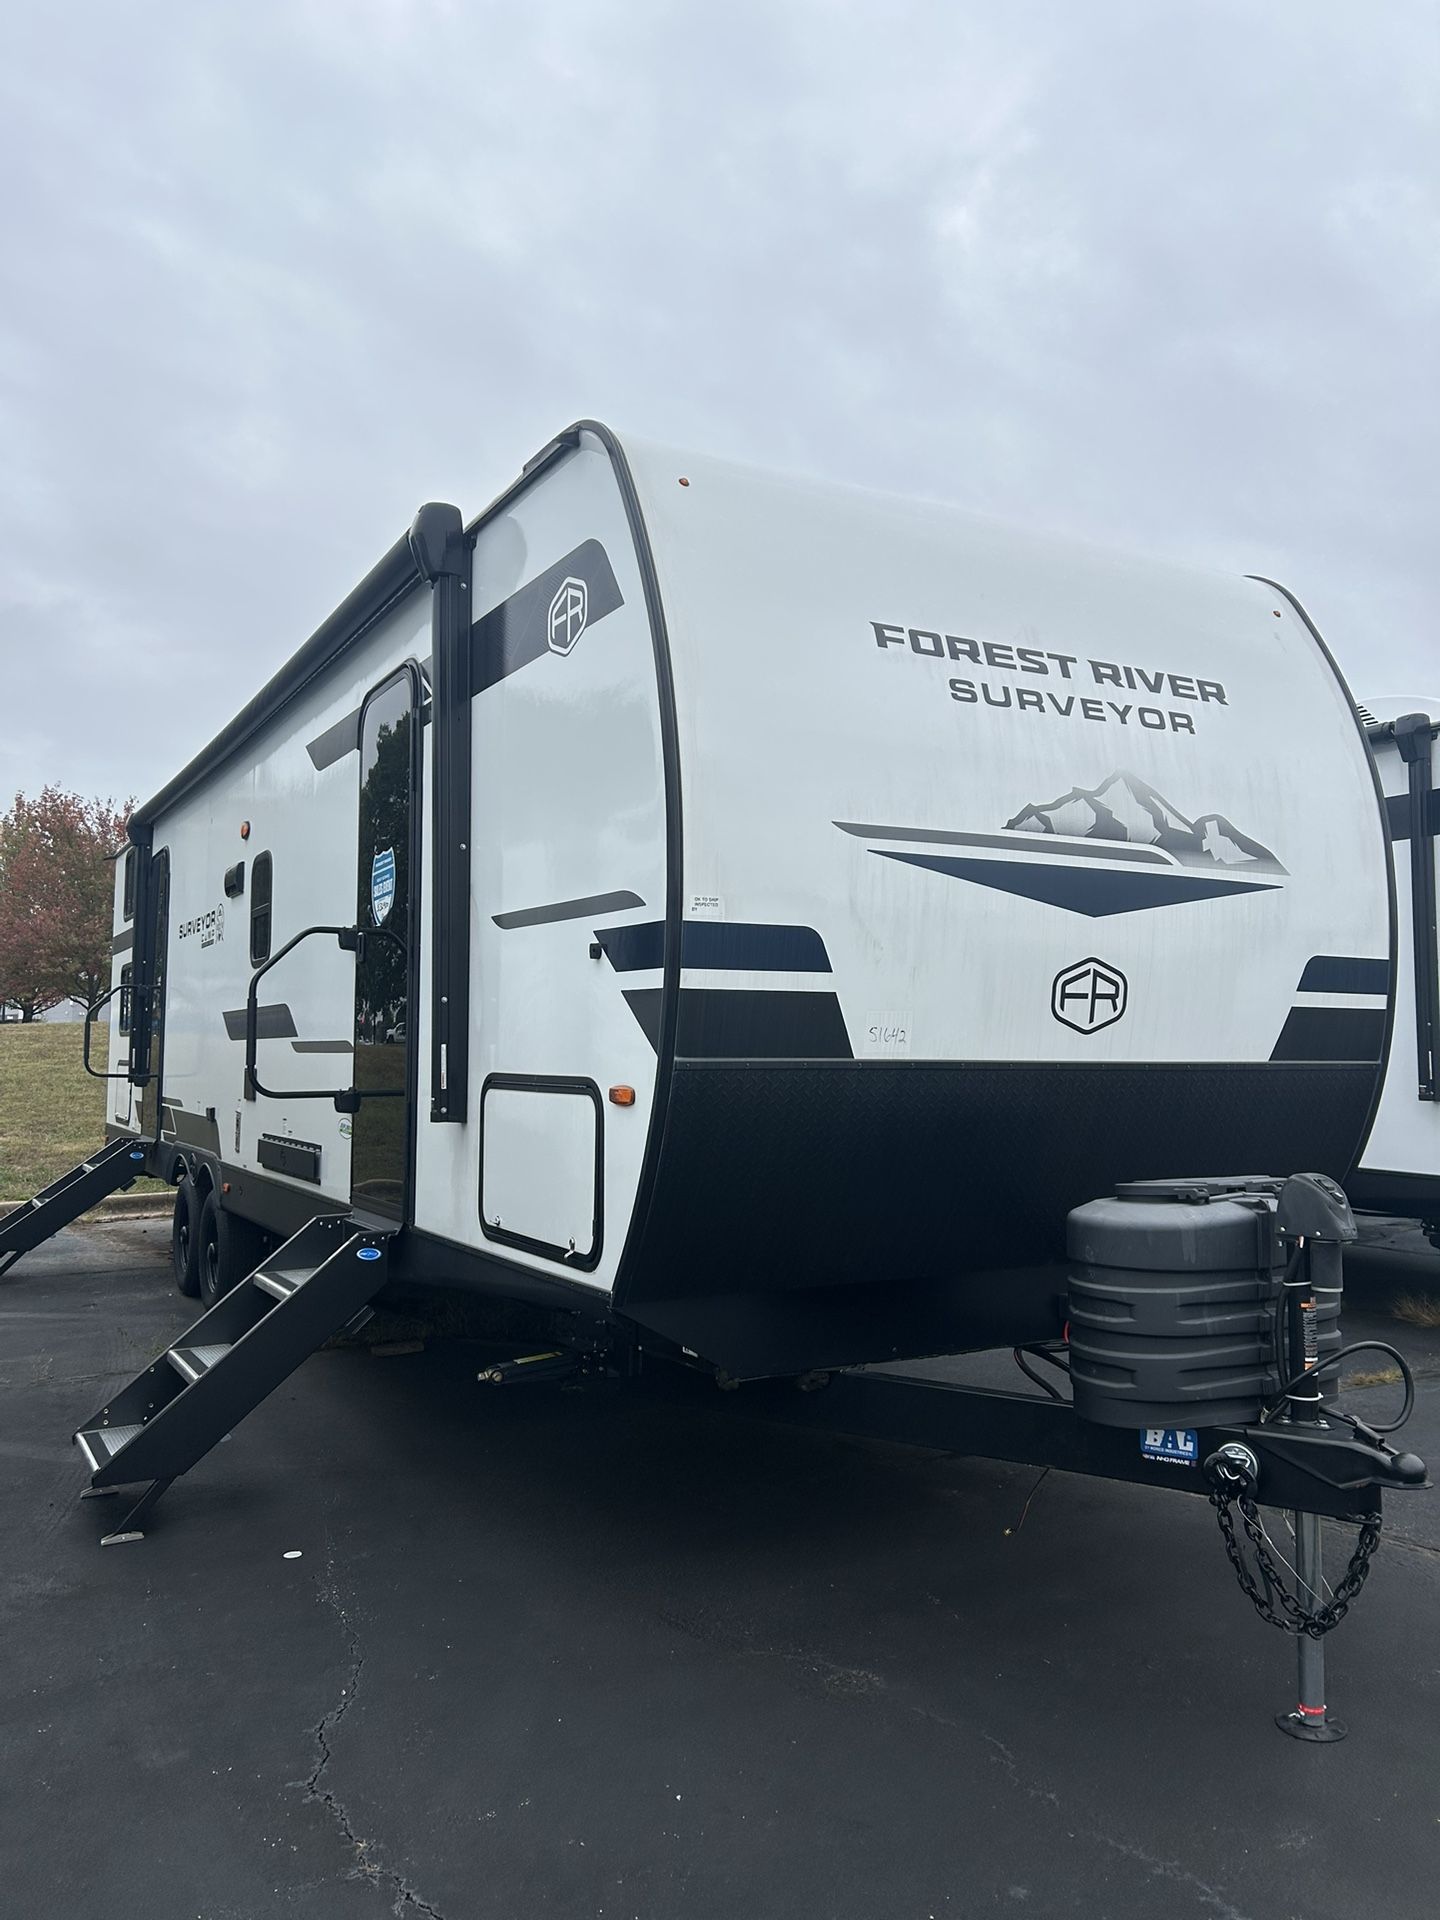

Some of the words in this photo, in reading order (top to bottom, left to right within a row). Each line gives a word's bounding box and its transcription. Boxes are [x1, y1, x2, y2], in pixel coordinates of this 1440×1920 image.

[869, 621, 1078, 679] FOREST
[1086, 659, 1229, 706] RIVER
[950, 678, 1196, 735] SURVEYOR
[179, 910, 216, 940] SURVEYOR
[1144, 1429, 1194, 1452] BAL
